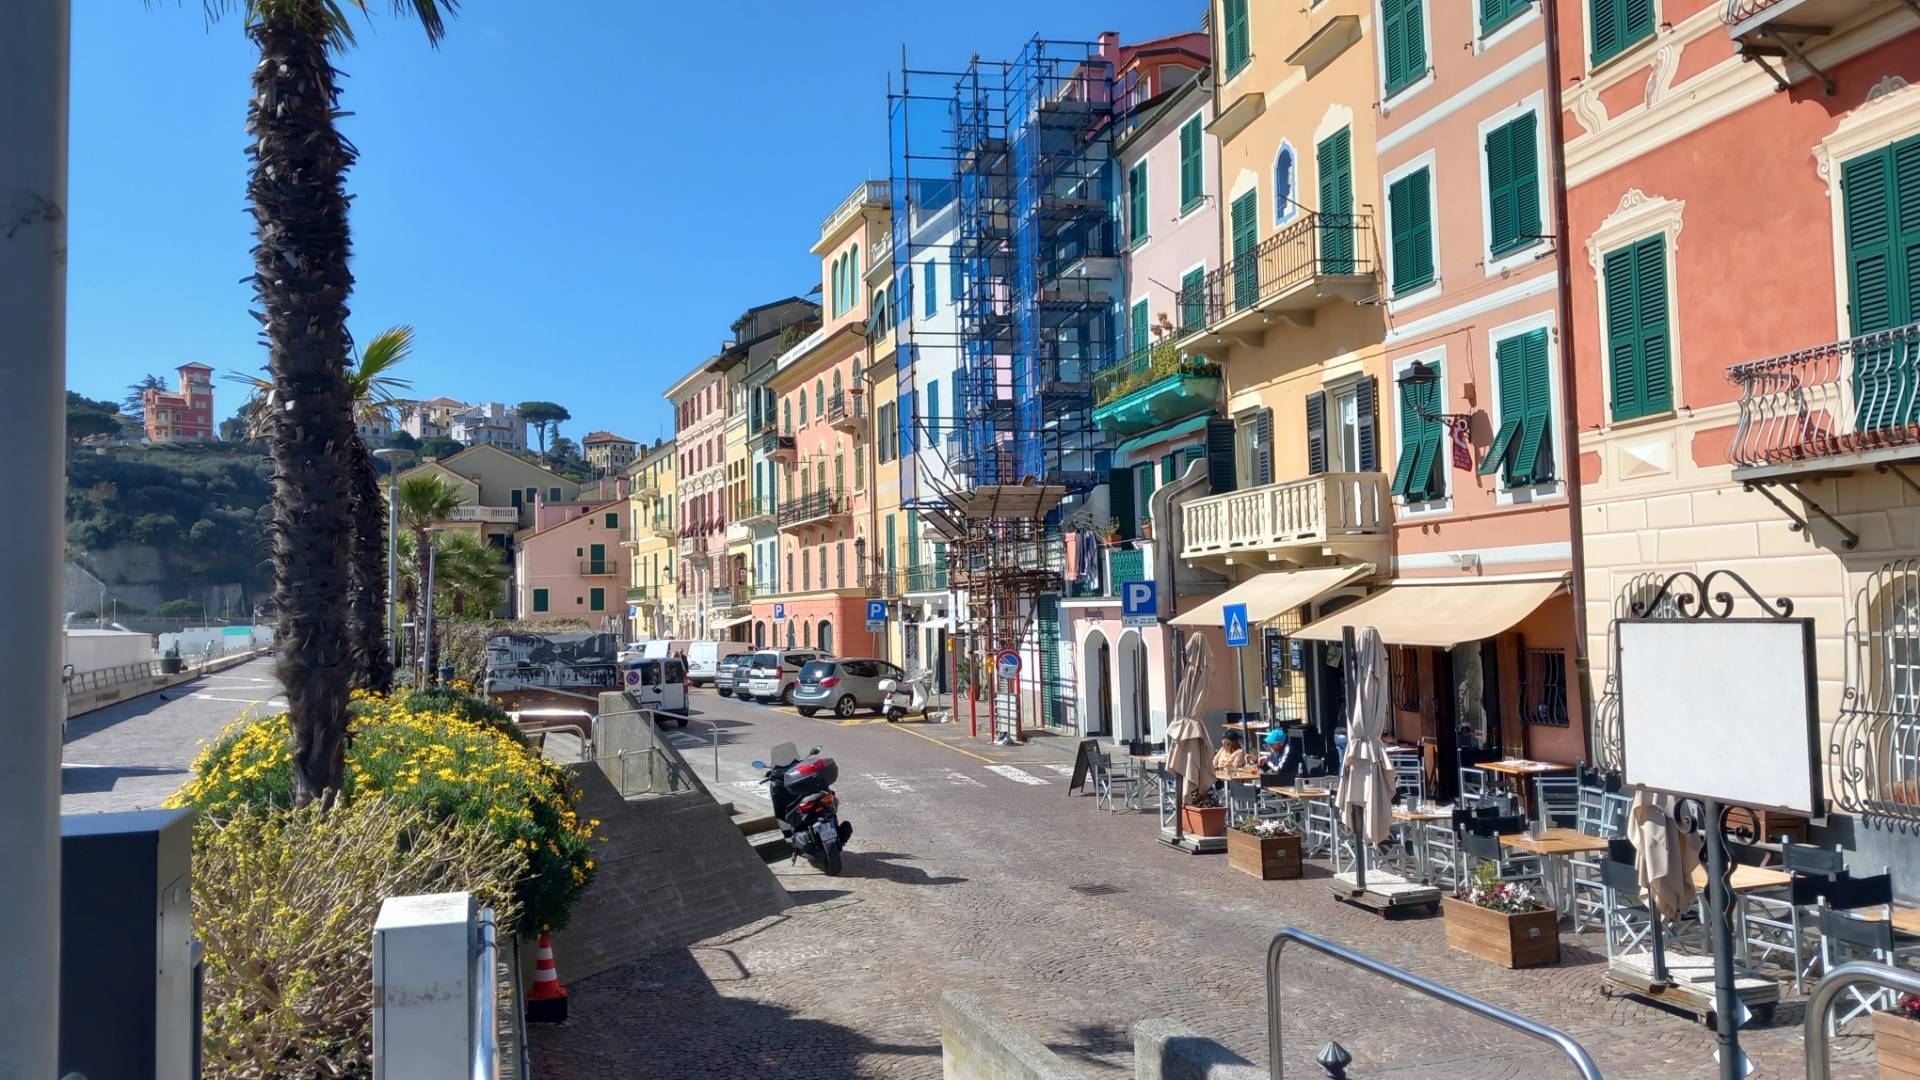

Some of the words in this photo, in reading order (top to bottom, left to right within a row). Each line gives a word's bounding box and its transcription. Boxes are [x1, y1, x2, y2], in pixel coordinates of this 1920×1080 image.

[1130, 584, 1151, 612] P
[776, 604, 783, 617] P
[871, 603, 881, 617] P
